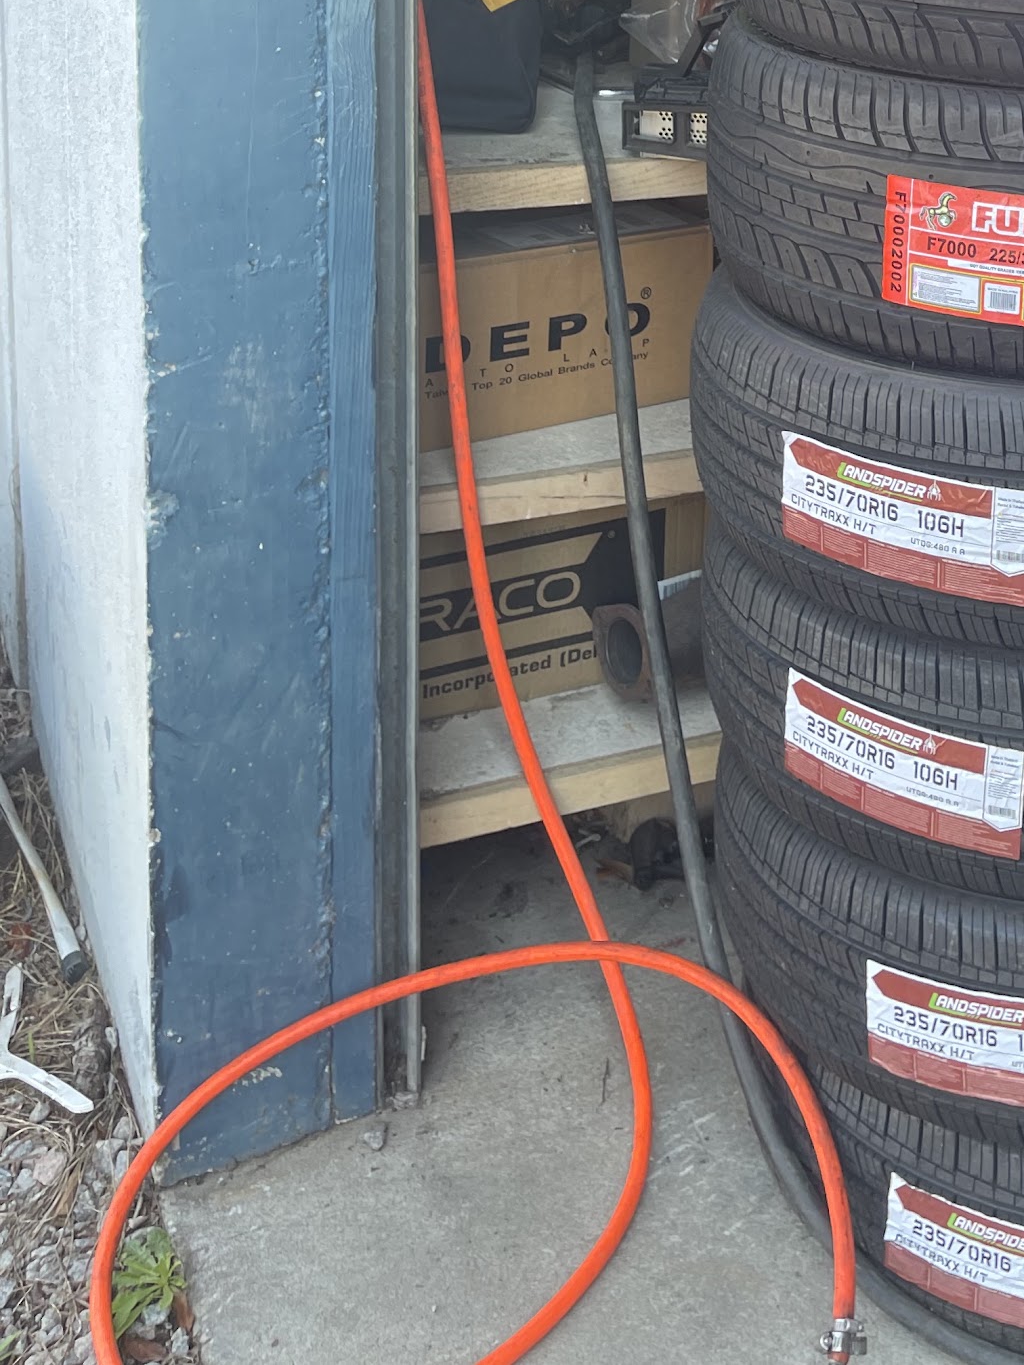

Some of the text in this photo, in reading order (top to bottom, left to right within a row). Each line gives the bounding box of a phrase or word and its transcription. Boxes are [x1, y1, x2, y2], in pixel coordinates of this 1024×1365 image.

[890, 191, 907, 293] F70002002
[927, 236, 977, 259] F7000
[472, 379, 493, 391] Top
[499, 376, 512, 386] 20
[518, 368, 553, 383] Global
[558, 361, 596, 376] Brands
[601, 351, 648, 367] Coany
[837, 461, 927, 502] LANDSPIDER
[791, 492, 877, 535] CITYTRAXX H/T
[804, 474, 899, 522] 235/70R16
[917, 509, 965, 538] 106H
[423, 656, 551, 699] Incorpated
[837, 707, 922, 751] LANDSPIDER
[792, 732, 874, 781] CITYTRAXX H/T
[806, 715, 958, 790] 235/70R16 106H
[877, 1023, 975, 1061] CITYTRAXX H/T
[893, 1005, 998, 1047] 235/70R16
[894, 1233, 988, 1283] CITYTRAXX H/T
[913, 1219, 1011, 1273] 235/70R16
